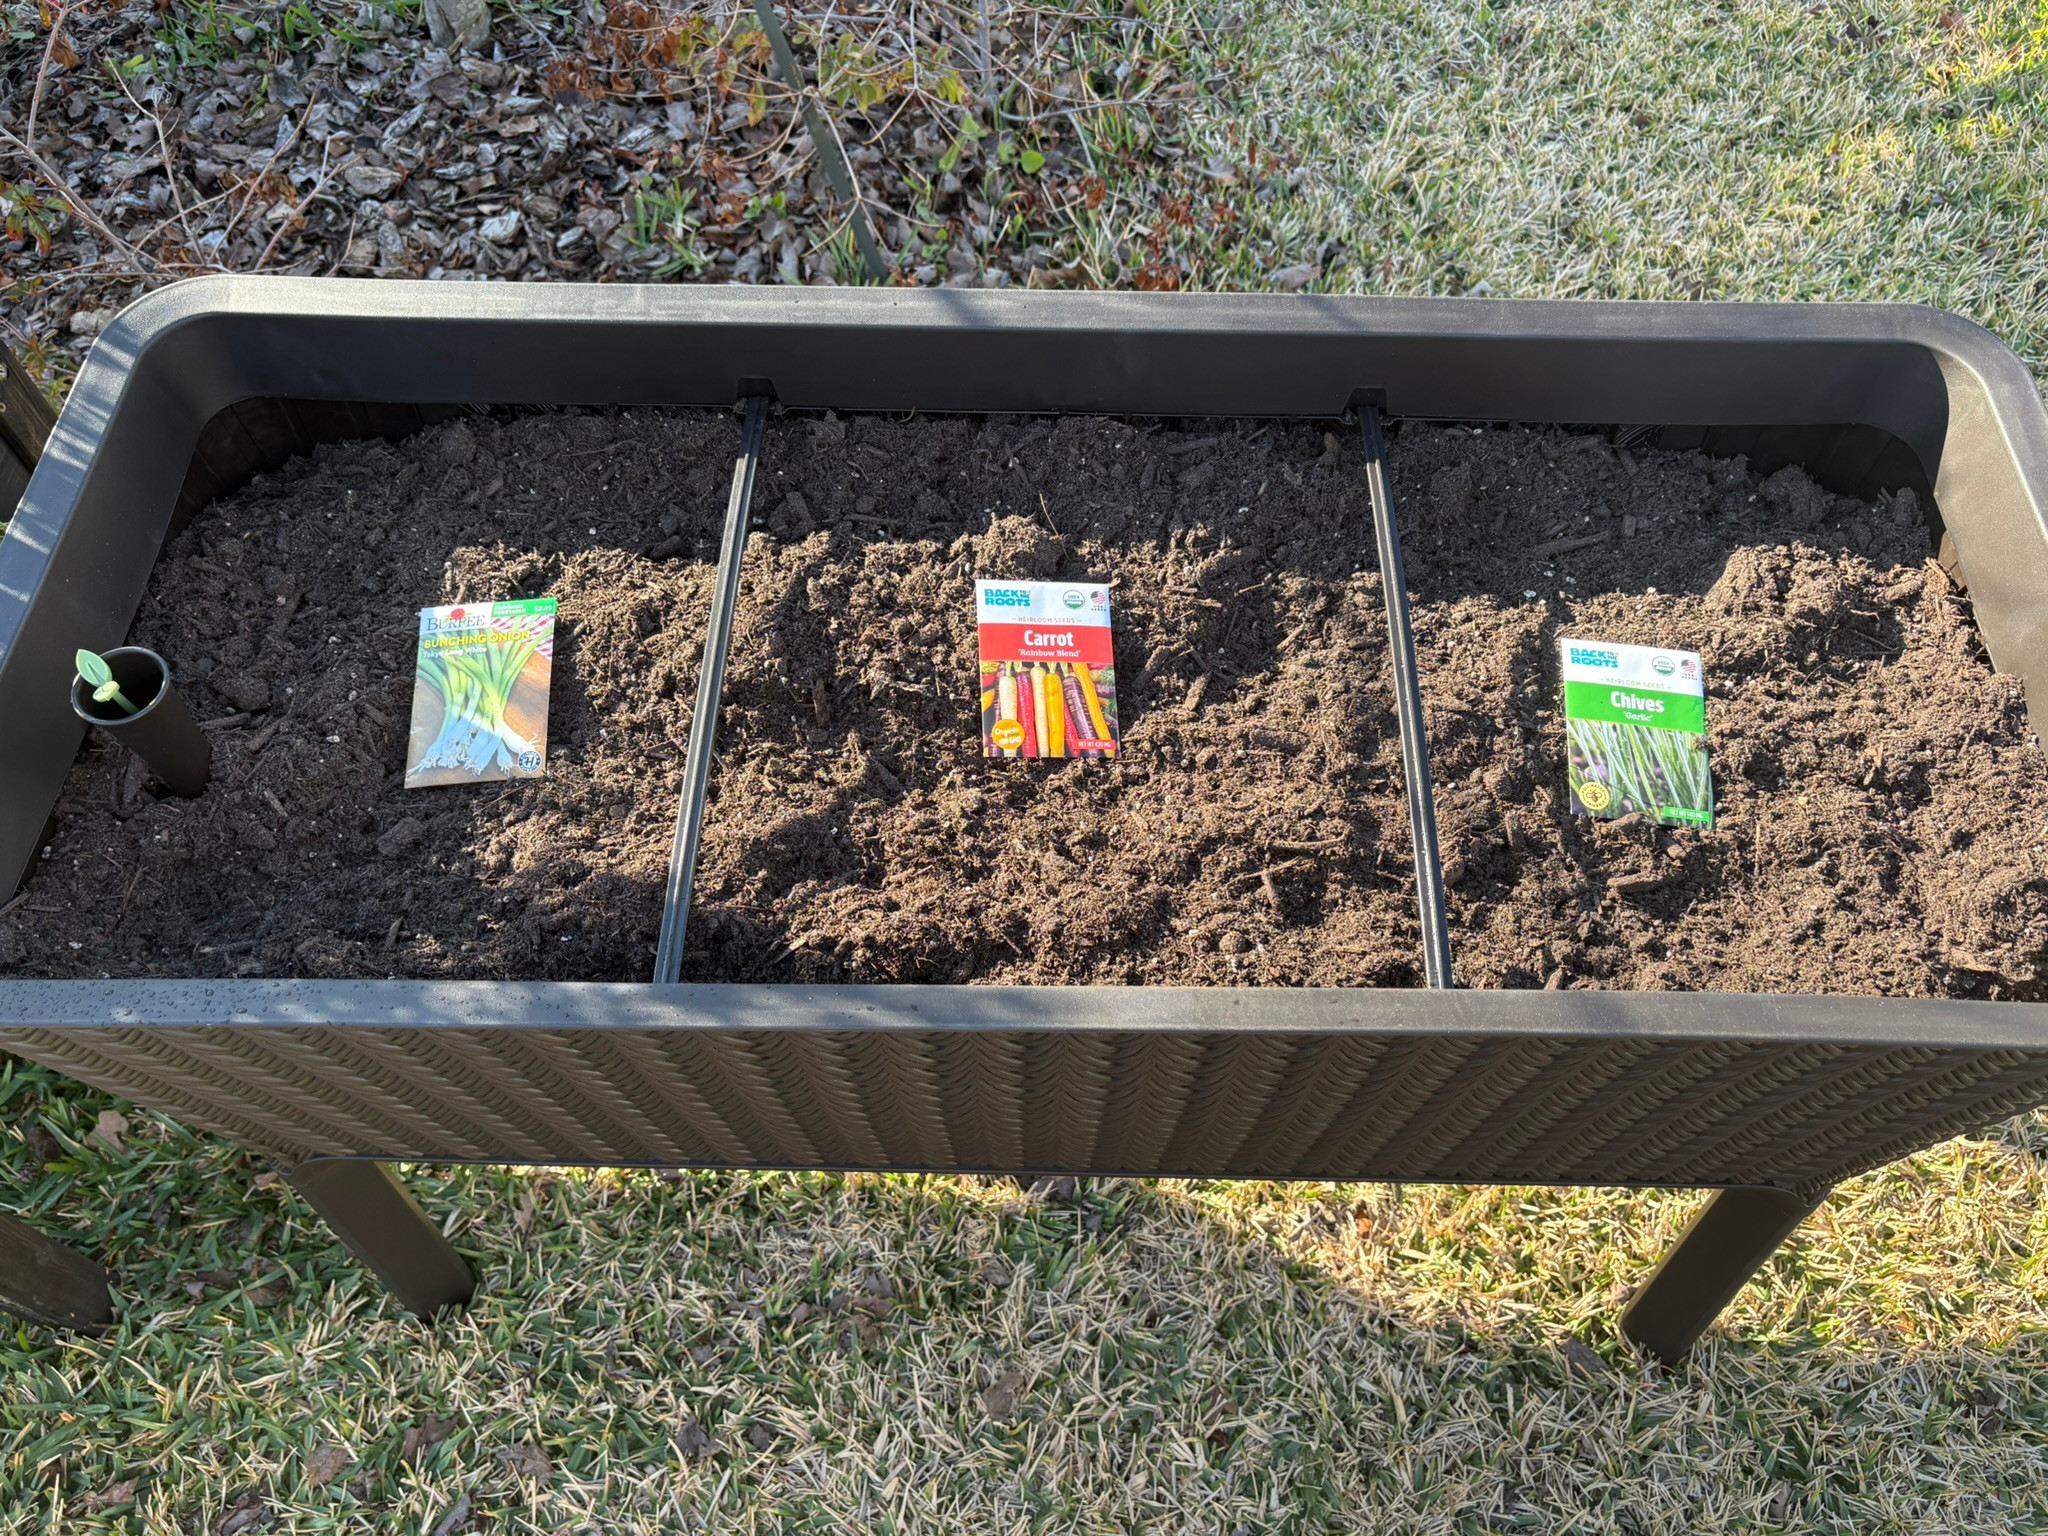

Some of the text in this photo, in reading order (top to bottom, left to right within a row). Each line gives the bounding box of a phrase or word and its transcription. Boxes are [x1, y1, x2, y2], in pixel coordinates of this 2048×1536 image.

[984, 589, 1019, 598] BACK
[985, 597, 1031, 607] ROOTS
[427, 615, 486, 631] BURPEE
[424, 630, 531, 649] BUNCHING ONION
[1023, 629, 1075, 647] Carrot
[465, 646, 487, 654] White
[1570, 648, 1606, 658] BACK
[1571, 656, 1619, 668] ROOTS
[1605, 678, 1665, 690] HEIRLOOM SEEDS
[1610, 690, 1665, 713] Chives
